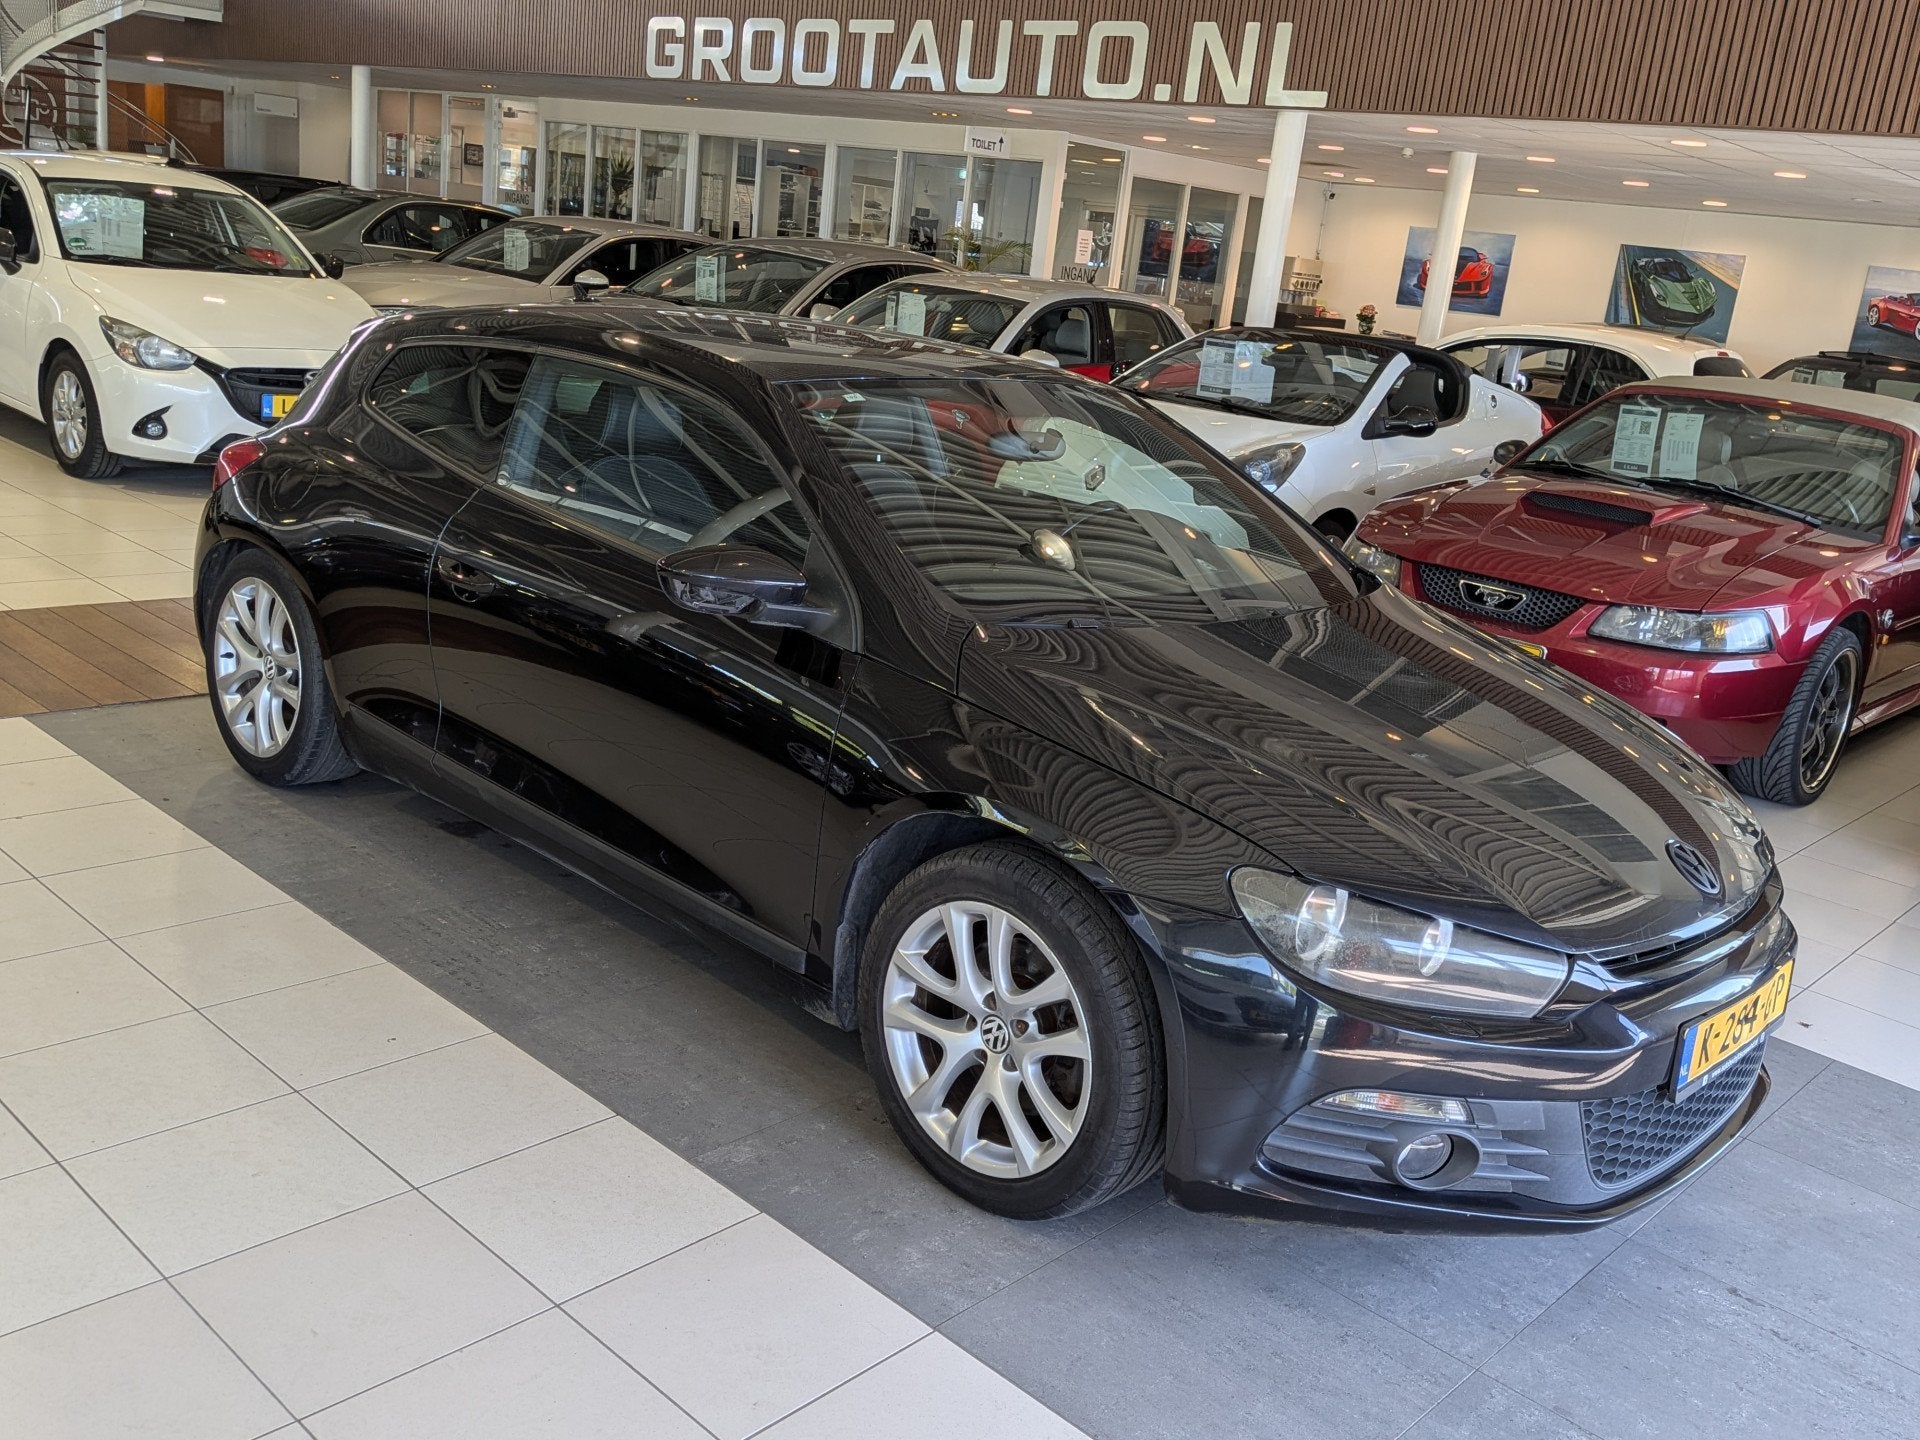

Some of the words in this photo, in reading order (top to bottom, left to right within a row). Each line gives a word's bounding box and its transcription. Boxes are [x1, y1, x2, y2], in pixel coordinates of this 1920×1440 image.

[645, 16, 1328, 108] GROOTAUTO.NL
[972, 138, 997, 151] TOILET
[504, 192, 530, 206] INGANG
[1061, 265, 1096, 283] INGANG
